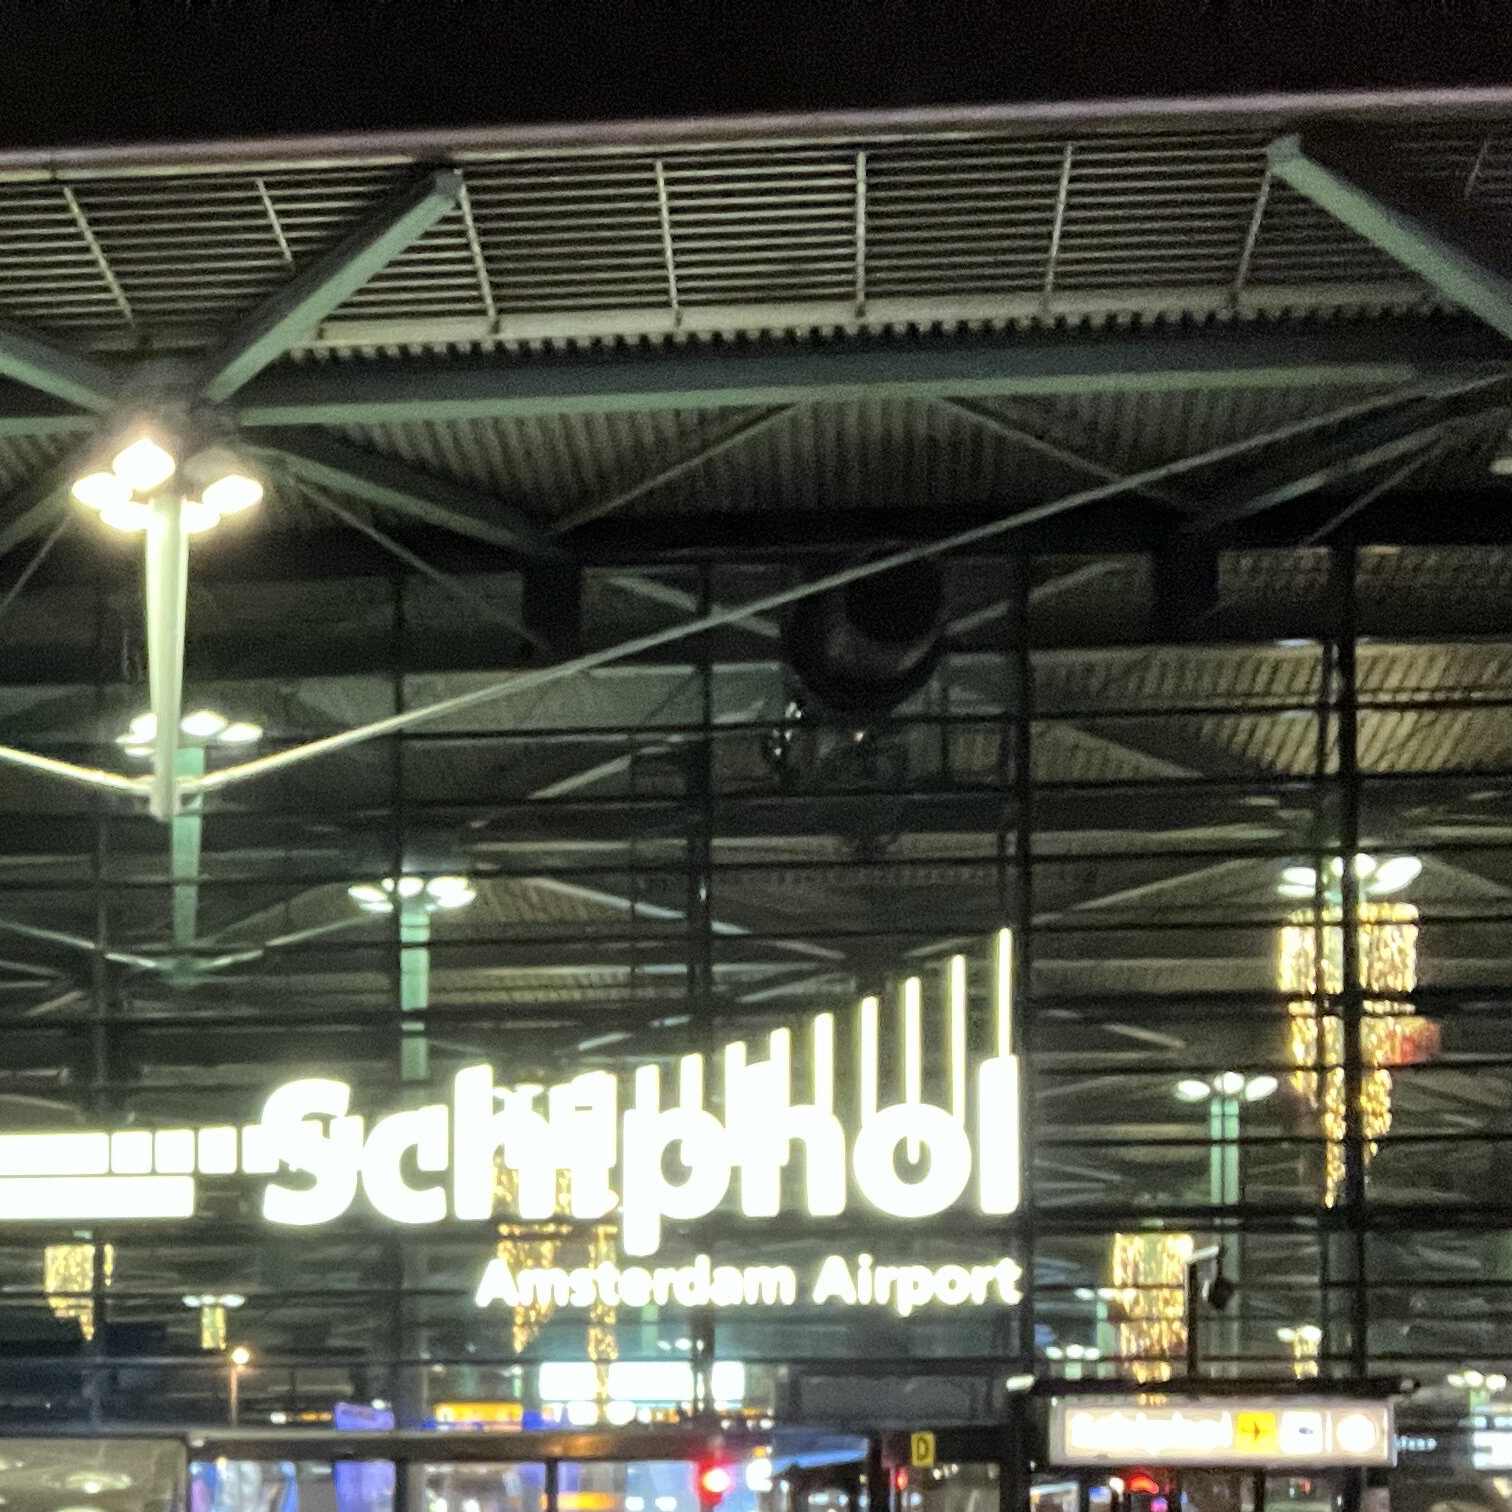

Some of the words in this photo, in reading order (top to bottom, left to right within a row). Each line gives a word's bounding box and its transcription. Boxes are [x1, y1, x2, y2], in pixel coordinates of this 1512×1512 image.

[262, 1056, 1020, 1257] Schiphol
[475, 1255, 795, 1307] Amsterdam
[812, 1254, 1022, 1316] Airport
[916, 1436, 930, 1461] D
